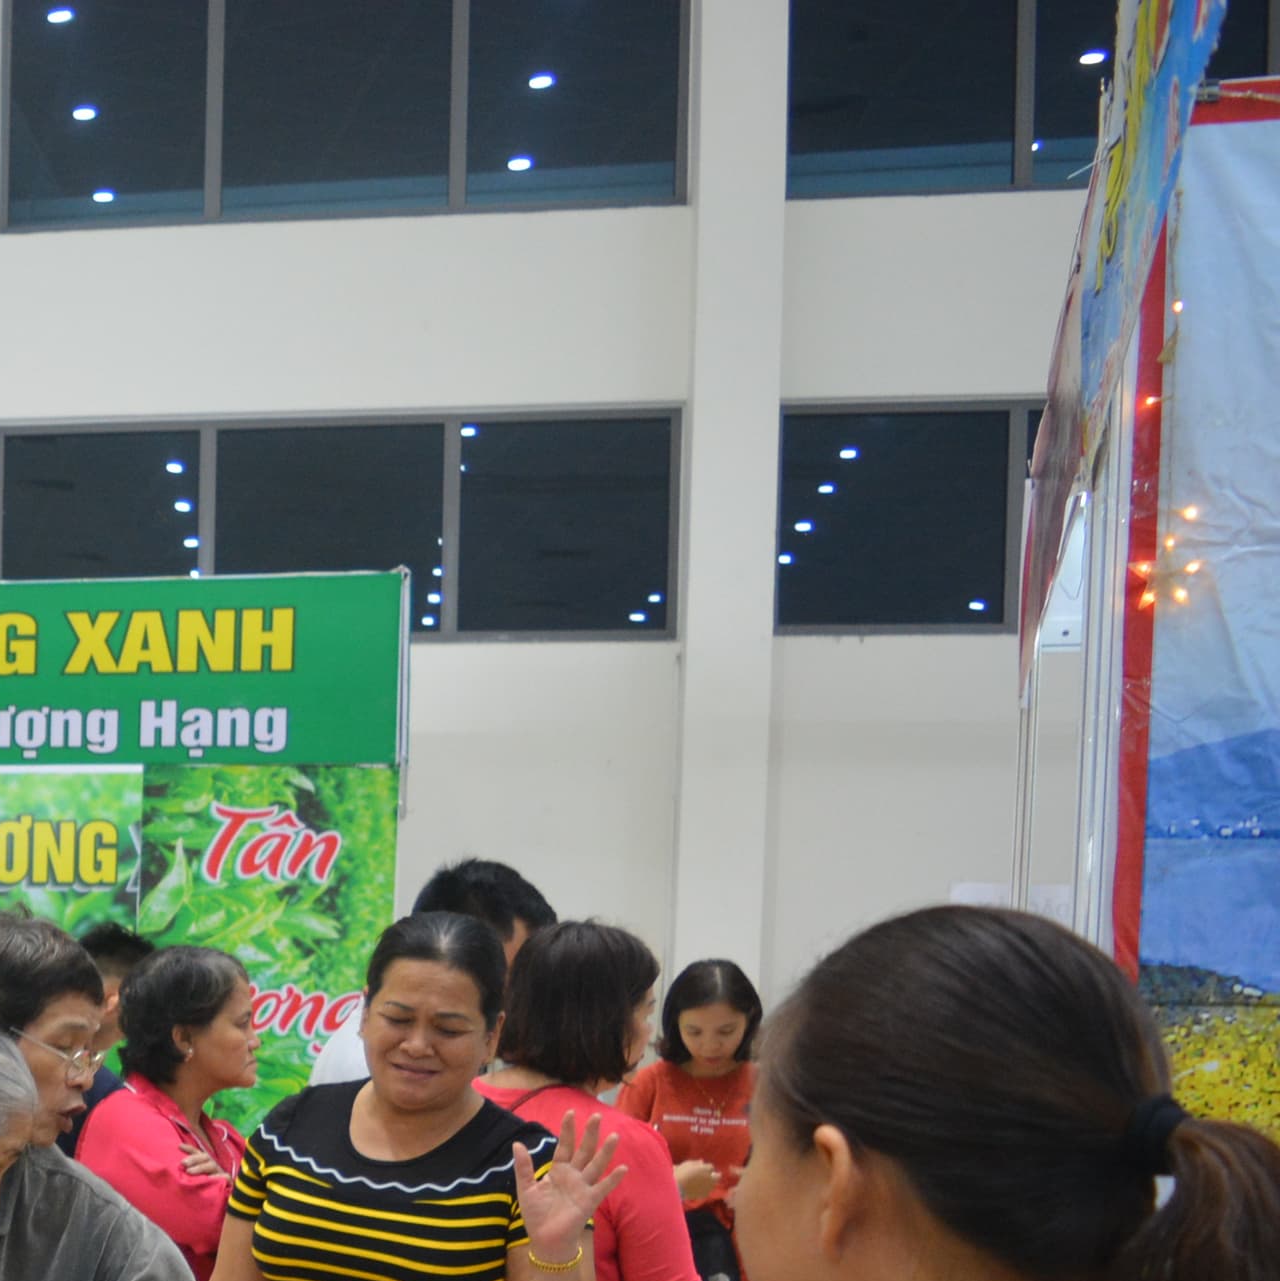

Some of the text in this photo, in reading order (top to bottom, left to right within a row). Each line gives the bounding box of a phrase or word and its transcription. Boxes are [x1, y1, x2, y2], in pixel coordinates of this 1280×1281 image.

[61, 606, 296, 675] XANH
[140, 700, 288, 758] Hạng
[204, 803, 342, 882] Tân
